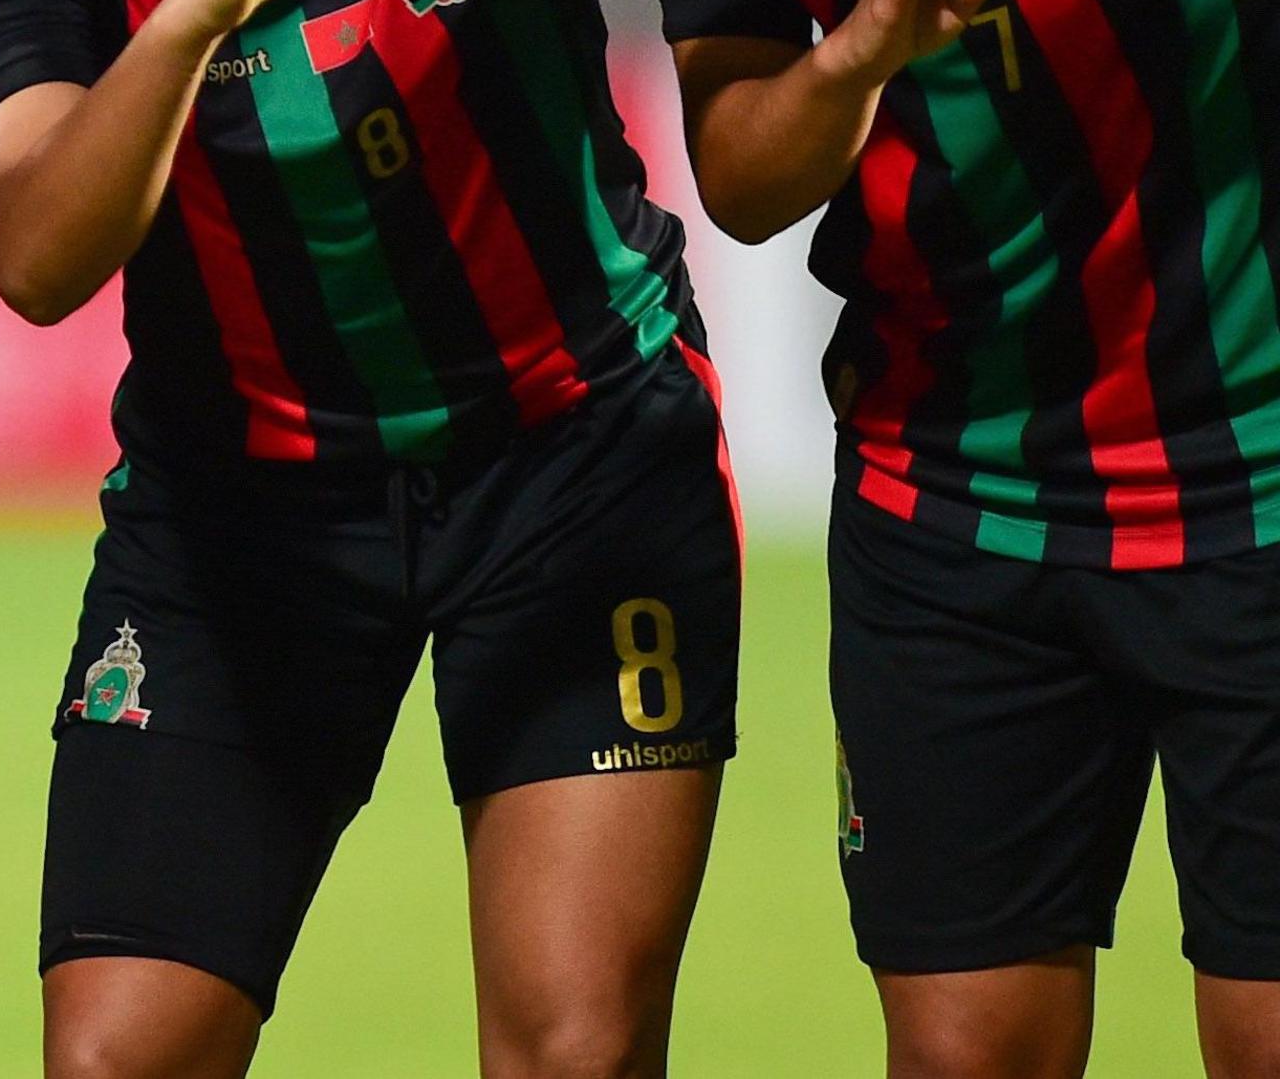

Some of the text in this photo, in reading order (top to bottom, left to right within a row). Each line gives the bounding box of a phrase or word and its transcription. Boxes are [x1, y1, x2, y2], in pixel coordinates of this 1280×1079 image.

[203, 49, 271, 85] sport
[968, 5, 1021, 92] 7
[357, 108, 409, 179] 8
[612, 597, 683, 733] 8
